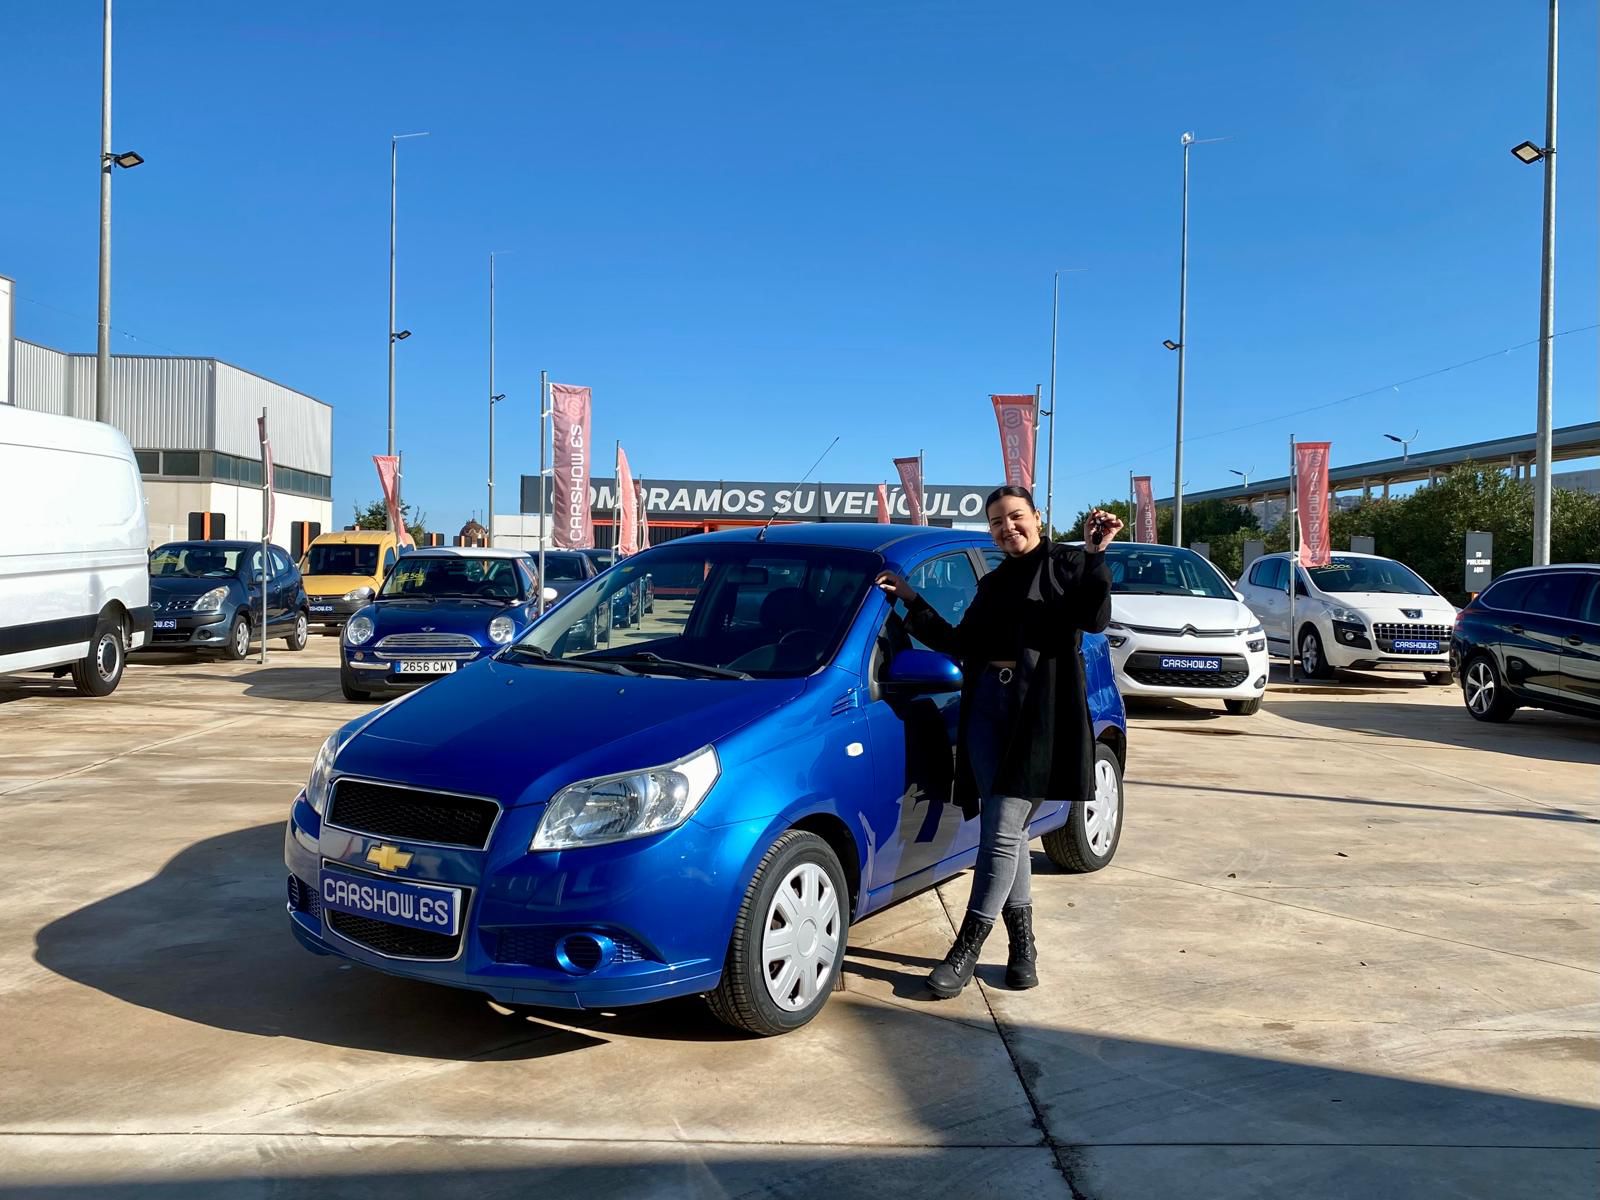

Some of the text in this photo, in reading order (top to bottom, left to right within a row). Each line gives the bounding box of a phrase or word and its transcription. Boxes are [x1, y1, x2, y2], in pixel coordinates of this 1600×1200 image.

[570, 424, 583, 541] CARSHOW.ES
[772, 489, 816, 514] SU
[824, 487, 983, 517] VEHÍCULO
[1395, 641, 1437, 649] CARSHOW.ES
[403, 661, 454, 672] 2656 CMY
[1162, 658, 1219, 669] CARSHOW.ES
[323, 878, 449, 925] CARSHOW.ES
